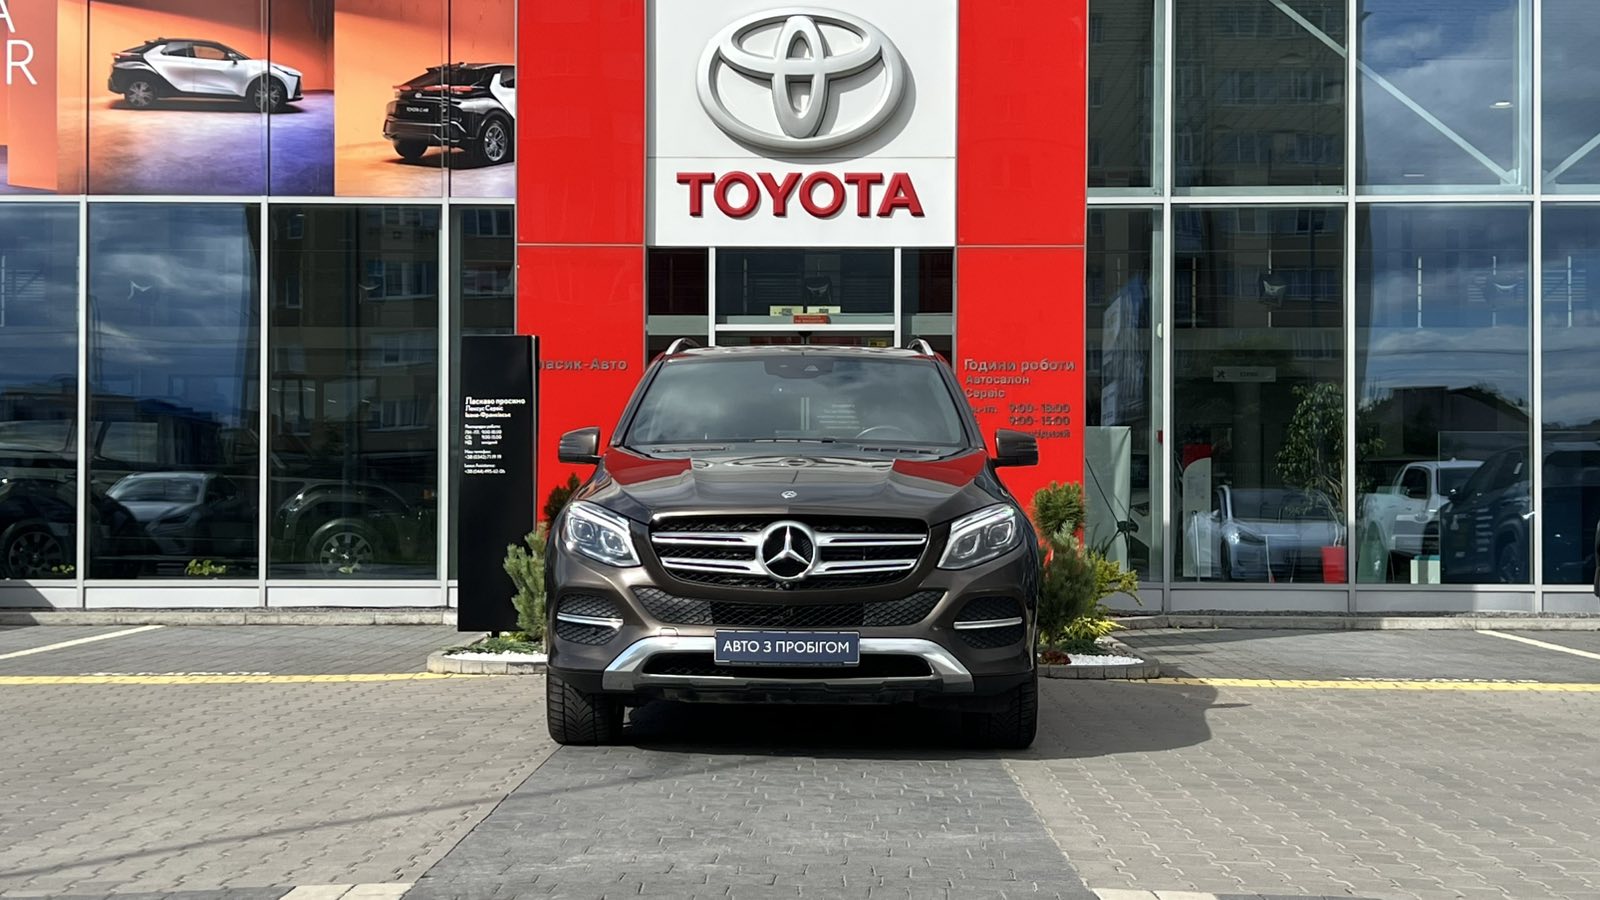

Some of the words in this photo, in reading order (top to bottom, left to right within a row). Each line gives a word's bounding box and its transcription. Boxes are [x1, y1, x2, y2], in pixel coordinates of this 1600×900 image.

[676, 170, 925, 219] TOYOTA
[964, 358, 1016, 372] Години
[1021, 358, 1075, 372] роботи
[965, 375, 1030, 385] Автосалон
[965, 388, 1005, 399] Сервіс
[465, 396, 495, 405] Ласкаво
[495, 398, 526, 406] просимо
[1009, 403, 1034, 413] 9:00
[1009, 415, 1034, 426] 9:00
[722, 640, 760, 653] АВТО
[775, 640, 850, 654] ПРОБІГОМ
